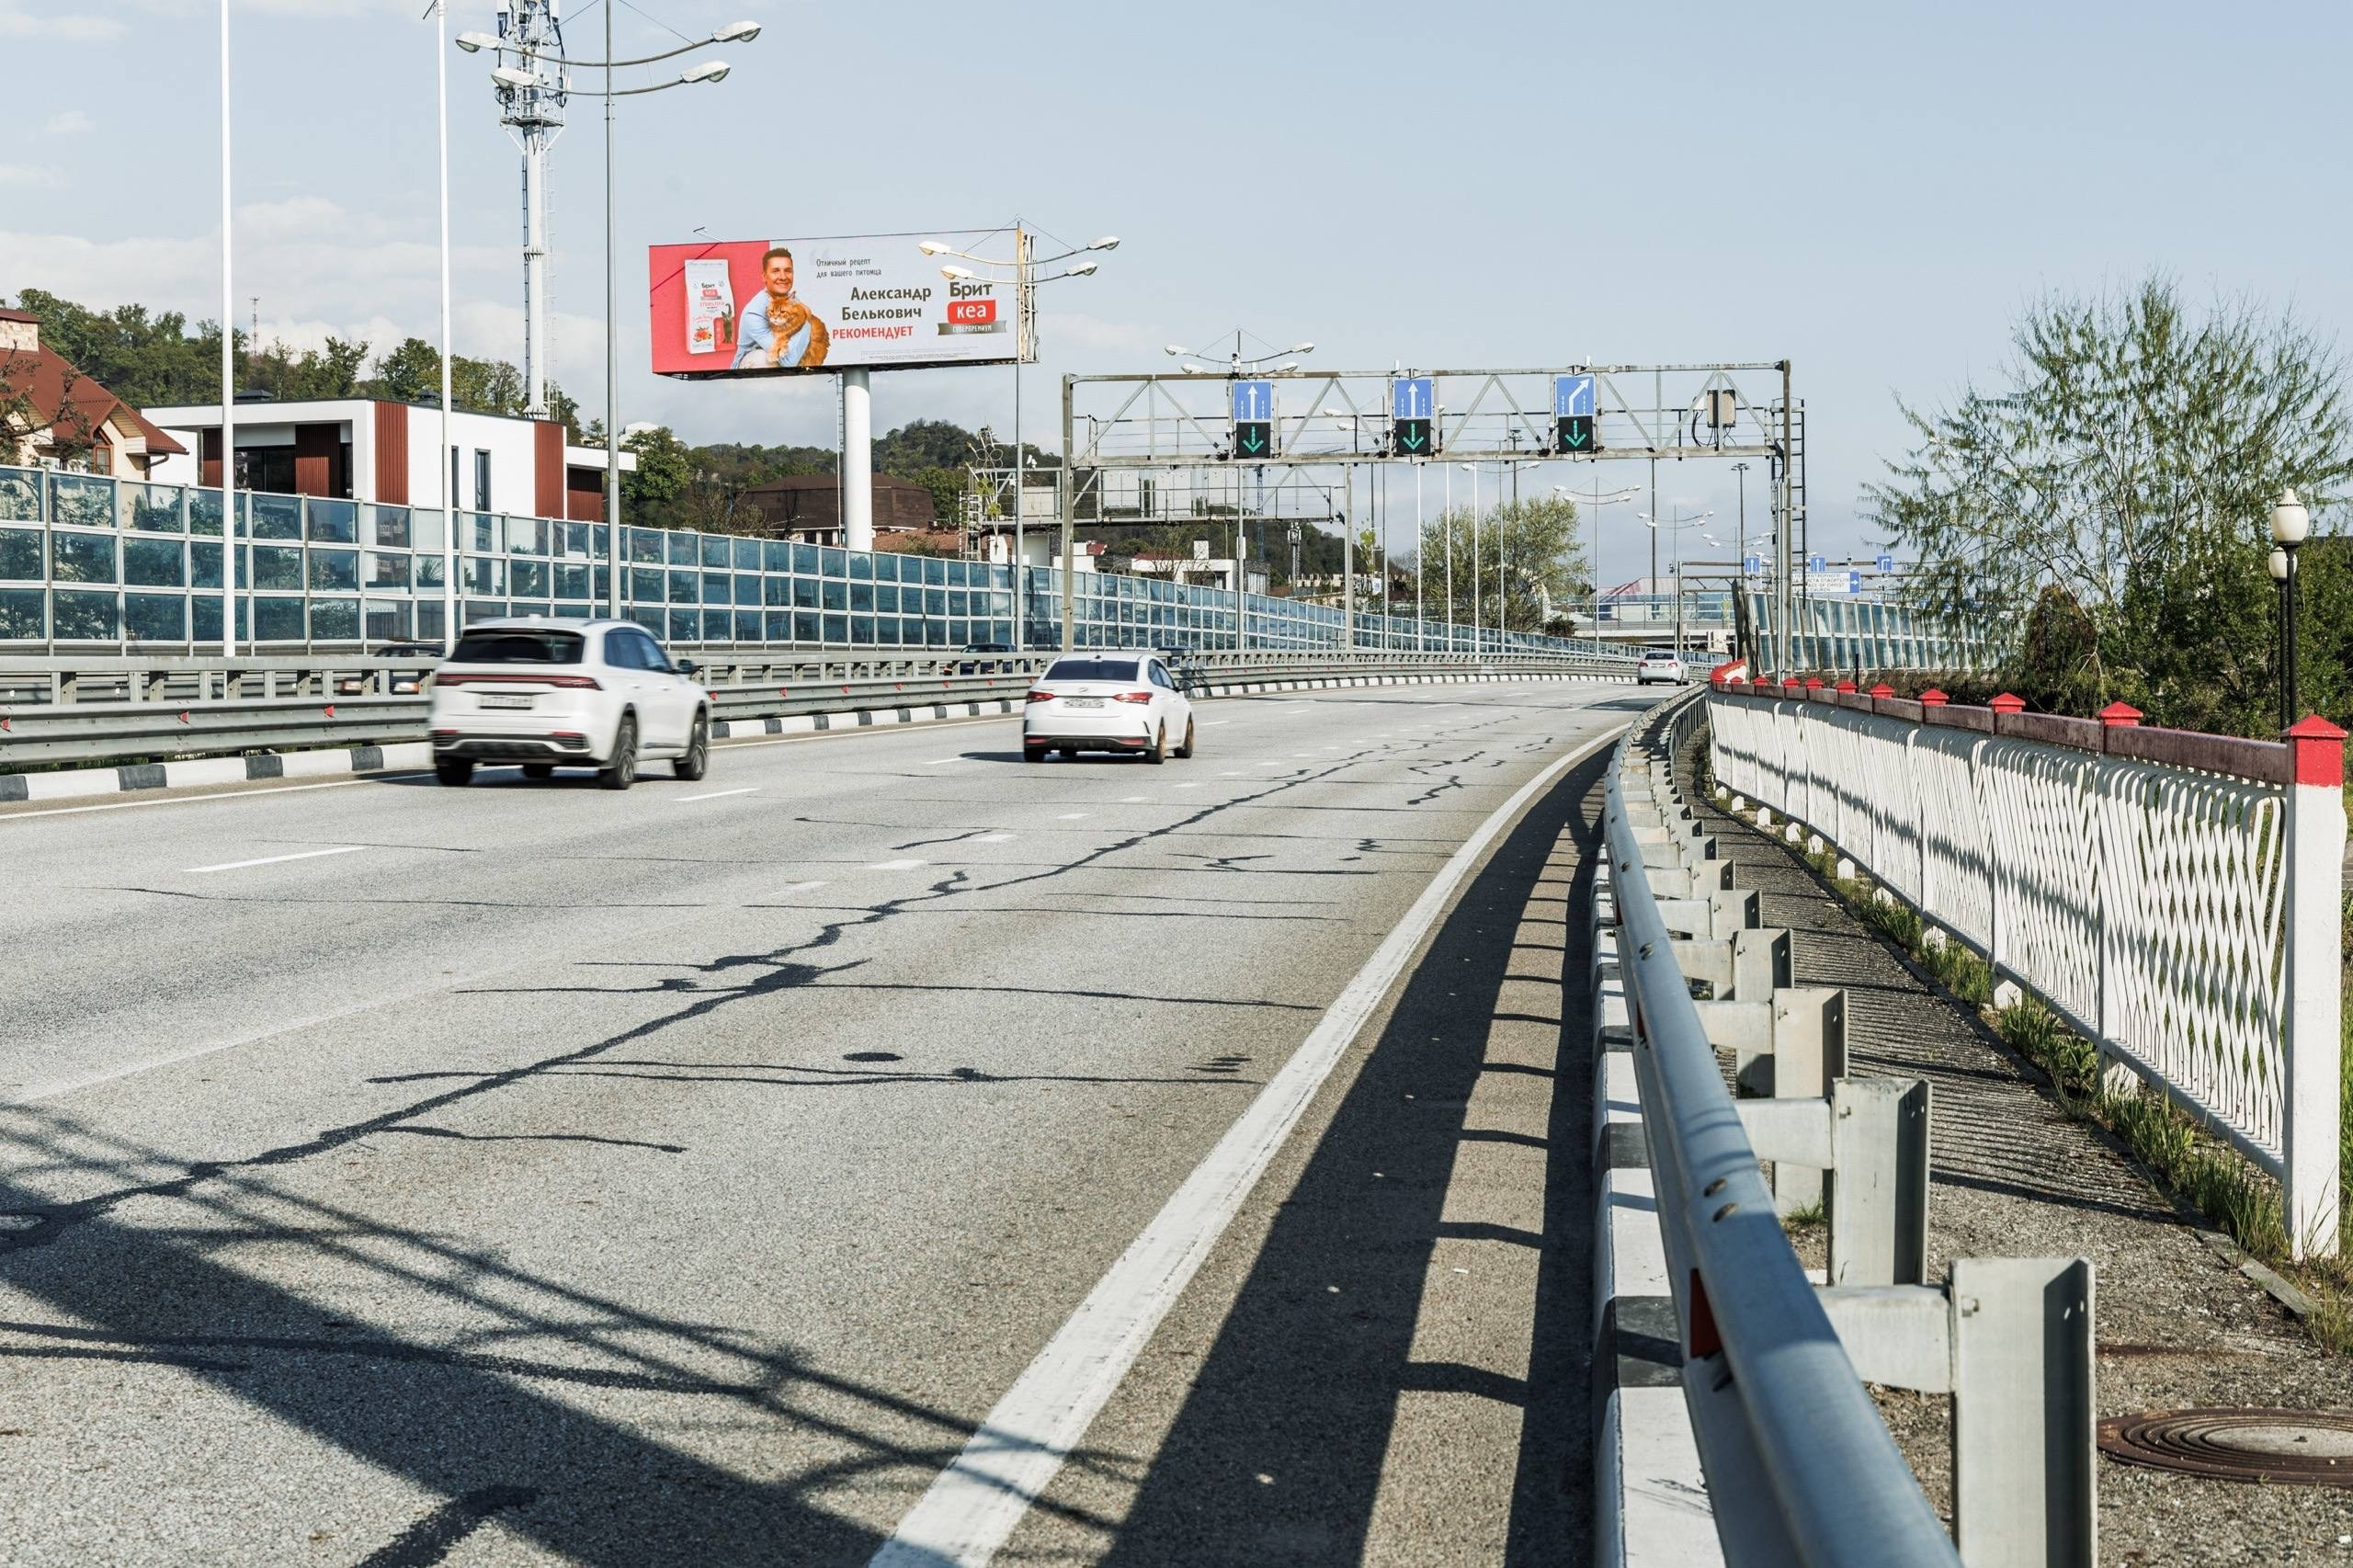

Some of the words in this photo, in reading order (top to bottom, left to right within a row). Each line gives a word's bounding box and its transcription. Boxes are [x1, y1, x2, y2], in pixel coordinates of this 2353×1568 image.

[816, 258, 847, 267] Отличный
[849, 258, 870, 267] рецепт
[850, 287, 931, 301] Александр
[949, 281, 993, 300] Брит
[842, 307, 922, 321] Белькович
[957, 304, 986, 319] кеа
[832, 326, 914, 339] РЕКОМЕНДУЕТ
